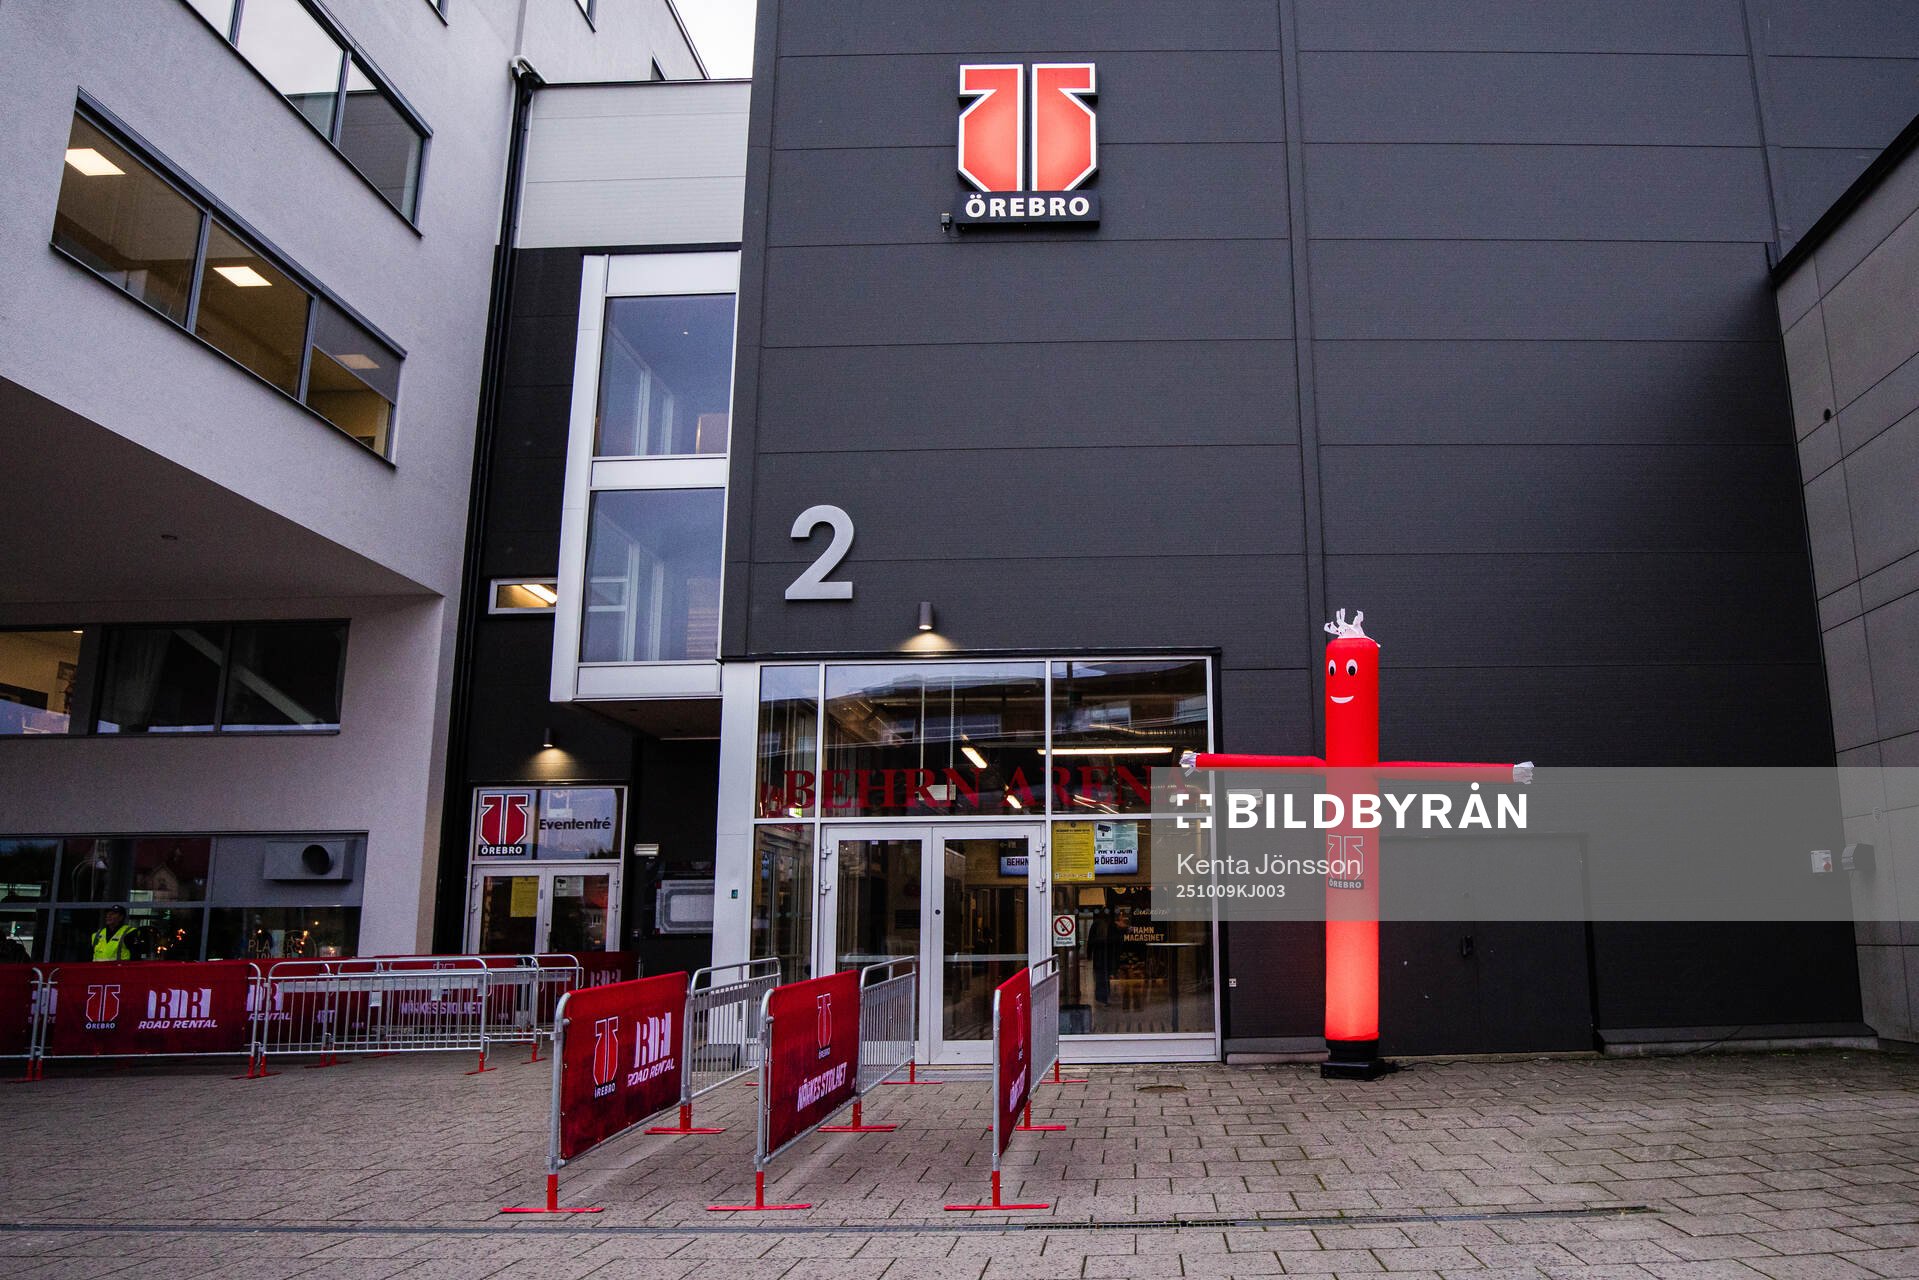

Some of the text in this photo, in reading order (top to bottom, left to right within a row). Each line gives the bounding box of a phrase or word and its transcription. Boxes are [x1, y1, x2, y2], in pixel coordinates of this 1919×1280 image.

[965, 193, 1090, 218] ÖREBRO
[784, 504, 855, 600] 2
[784, 765, 1195, 809] BEHRN ARENA
[539, 817, 612, 830] Evententré
[481, 845, 523, 855] ÖREBRO
[1100, 855, 1128, 864] ÖREBRO
[1328, 878, 1362, 889] ÖREBRO
[138, 1019, 219, 1029] ROAD RENTAL
